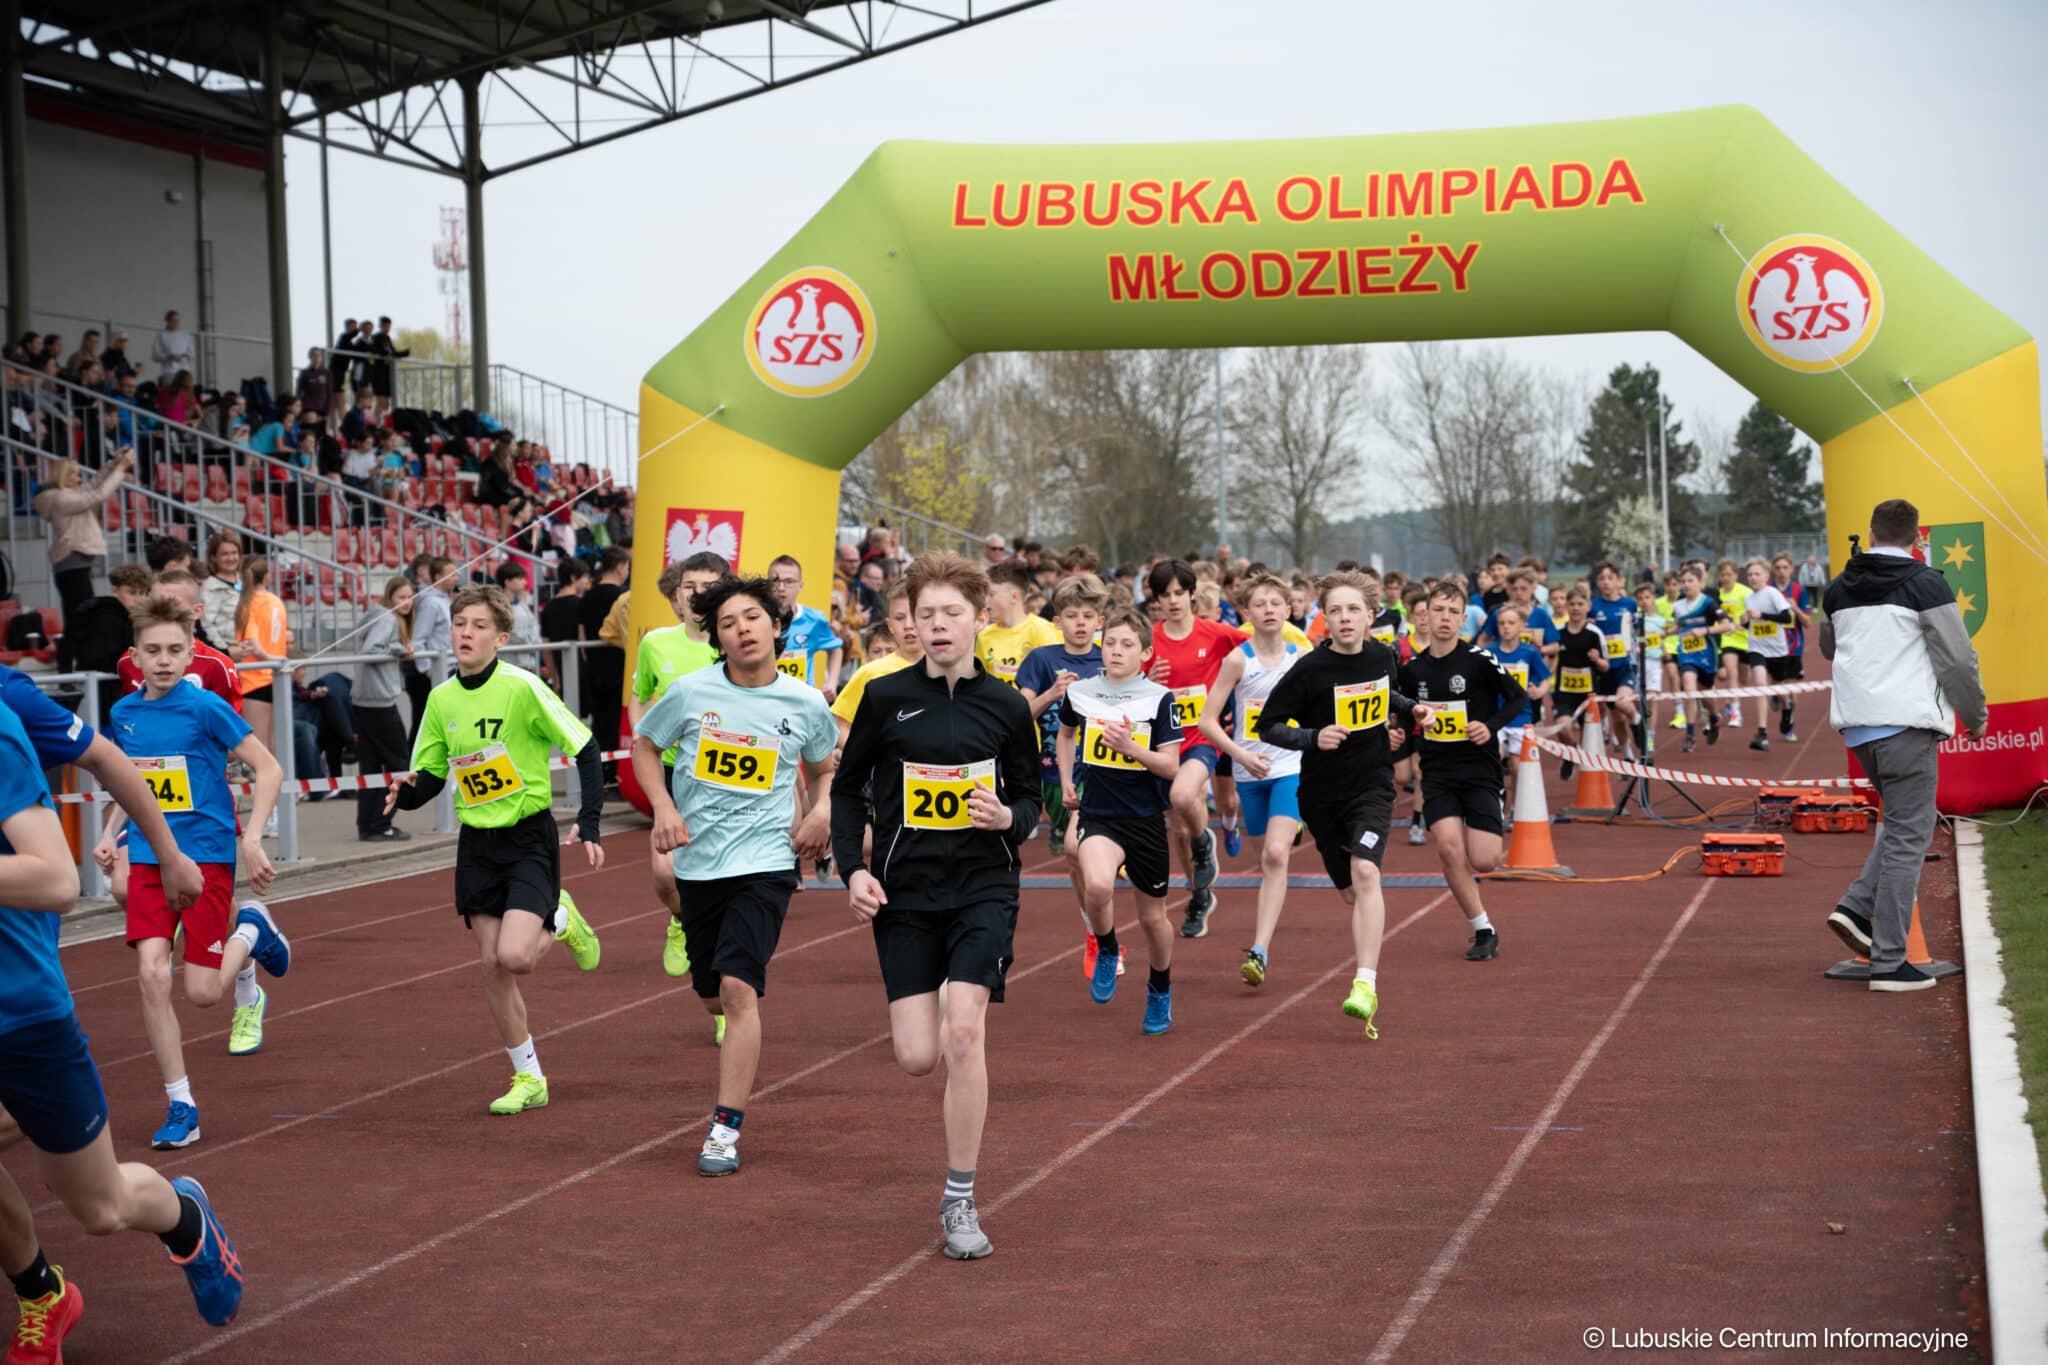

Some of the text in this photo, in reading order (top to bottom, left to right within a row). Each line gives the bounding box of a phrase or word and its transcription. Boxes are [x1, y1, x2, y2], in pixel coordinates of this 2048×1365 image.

[953, 158, 1645, 228] LUBUSKA OLIMPIADA
[1107, 232, 1481, 302] MŁODZIEŻY
[1772, 302, 1850, 341] SZS
[768, 332, 843, 366] SZS
[1347, 695, 1382, 725] 172
[474, 717, 504, 740] 17
[462, 768, 514, 798] 153.
[704, 749, 766, 783] 159.
